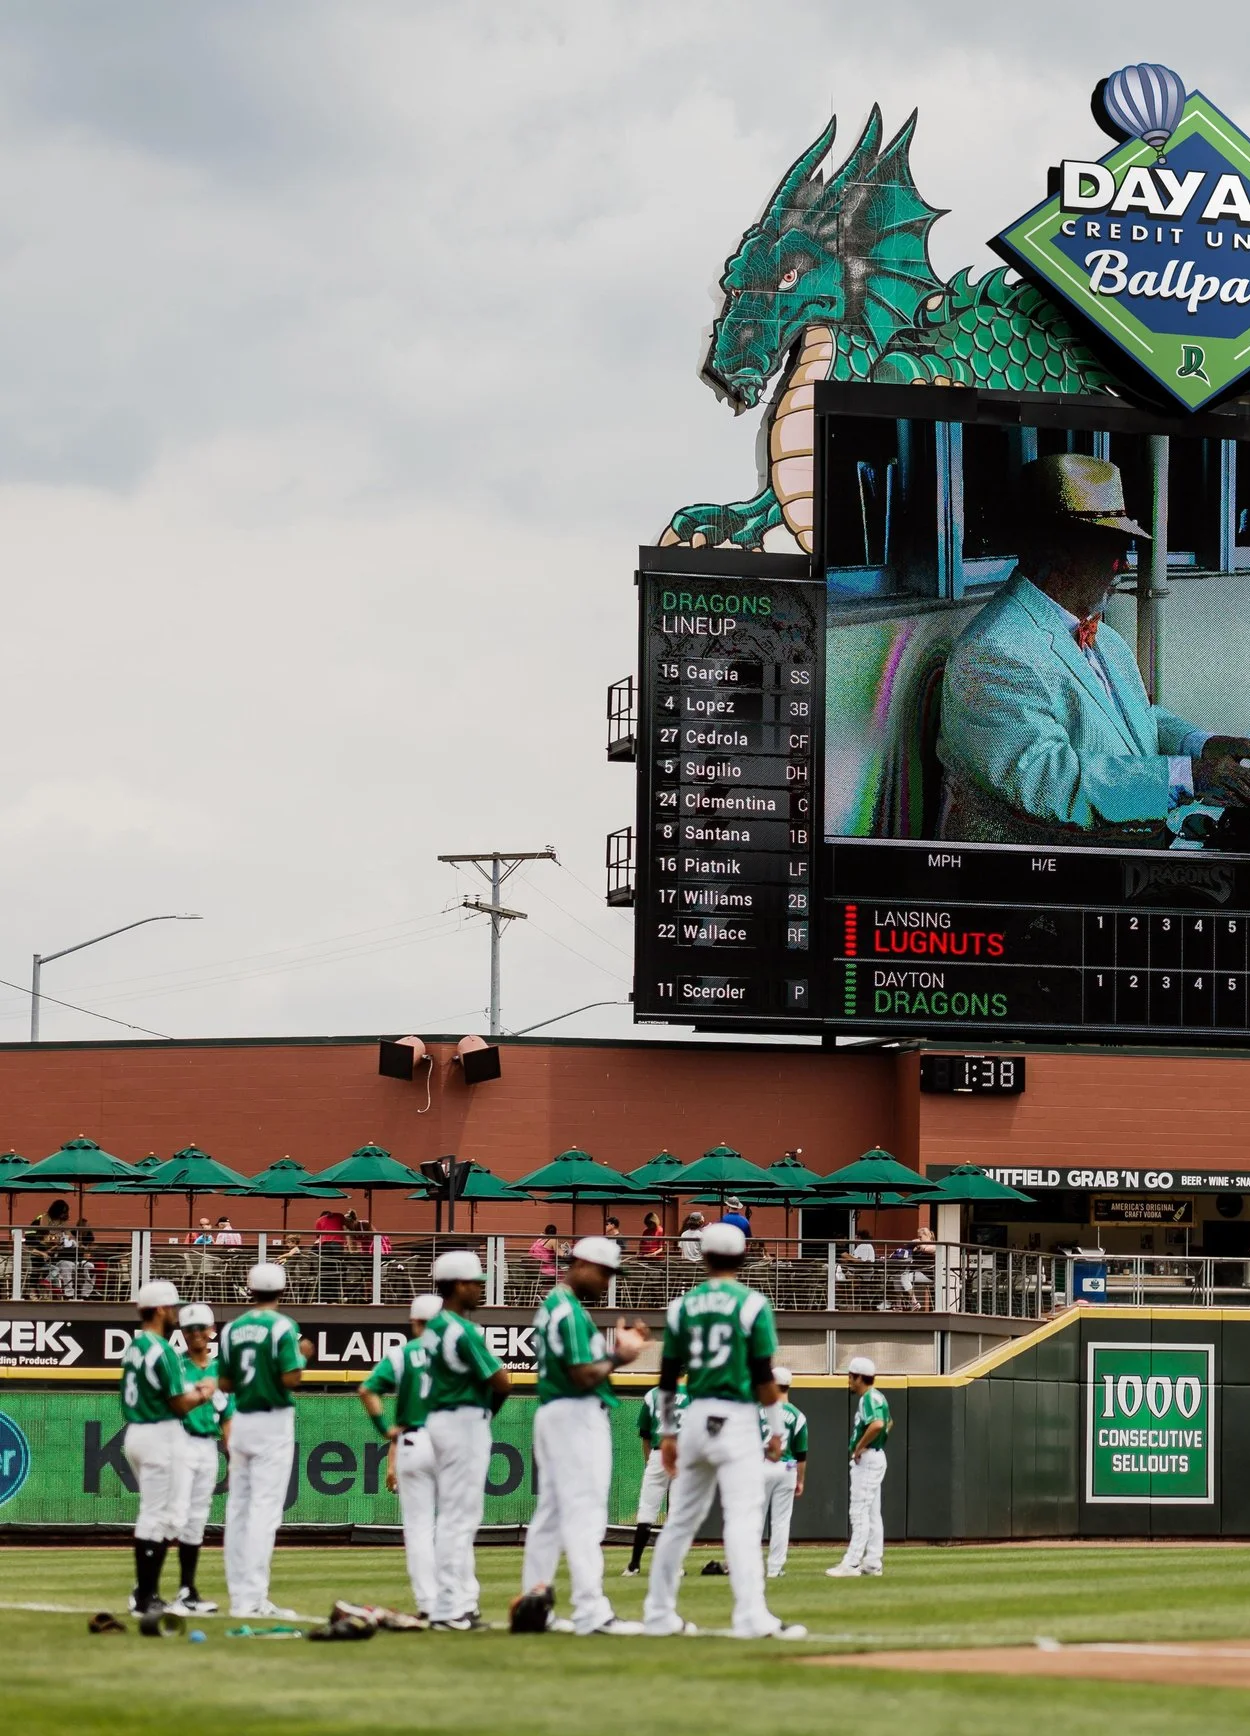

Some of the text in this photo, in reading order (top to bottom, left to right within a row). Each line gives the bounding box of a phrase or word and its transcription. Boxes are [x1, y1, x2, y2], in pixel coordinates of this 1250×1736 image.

[1062, 160, 1205, 216] DAY
[1061, 219, 1183, 244] CREDIT
[663, 592, 771, 615] DRAGONS
[663, 616, 736, 635] LINEUP
[662, 664, 809, 684] 15 Garcia SS
[665, 696, 808, 716] 4 Lopez 3B
[661, 729, 808, 748] 27 Cedrola CF
[665, 760, 807, 780] 5 Sugilio DH
[660, 793, 807, 811] 24 Clementina C
[664, 825, 807, 843] 8 Santana 1B
[660, 858, 806, 876] 16 Piatnik LF
[929, 855, 1056, 871] MPH H/E
[659, 890, 806, 908] 17 Williams 2B
[876, 911, 950, 928] LANSING
[1098, 916, 1102, 928] 1
[1130, 918, 1138, 929] 2
[1163, 919, 1170, 930] 3
[1195, 920, 1202, 931] 4
[1229, 921, 1236, 932] 5
[659, 924, 806, 941] 22 Wallace RF
[876, 930, 1003, 955] LUGNUTS
[875, 971, 943, 988] DAYTON
[1098, 975, 1102, 986] 1
[1130, 976, 1137, 987] 2
[1163, 977, 1170, 988] 3
[1195, 978, 1202, 989] 4
[1229, 979, 1235, 990] 5
[658, 983, 804, 999] 11 Sceroler P
[875, 990, 1007, 1016] DRAGONS
[965, 1061, 1014, 1087] 1:38
[981, 1169, 1060, 1186] UTFIELD
[1067, 1169, 1119, 1187] GRAB
[1144, 1171, 1173, 1189] GO
[1181, 1175, 1201, 1186] BEER
[1208, 1176, 1229, 1186] WINE
[1111, 1203, 1144, 1211] AMERICA'S
[19, 1357, 58, 1365] Products
[1100, 1374, 1202, 1419] 1000
[1098, 1429, 1202, 1448] CONSECUTIVE
[1112, 1454, 1189, 1473] SELLOUTS
